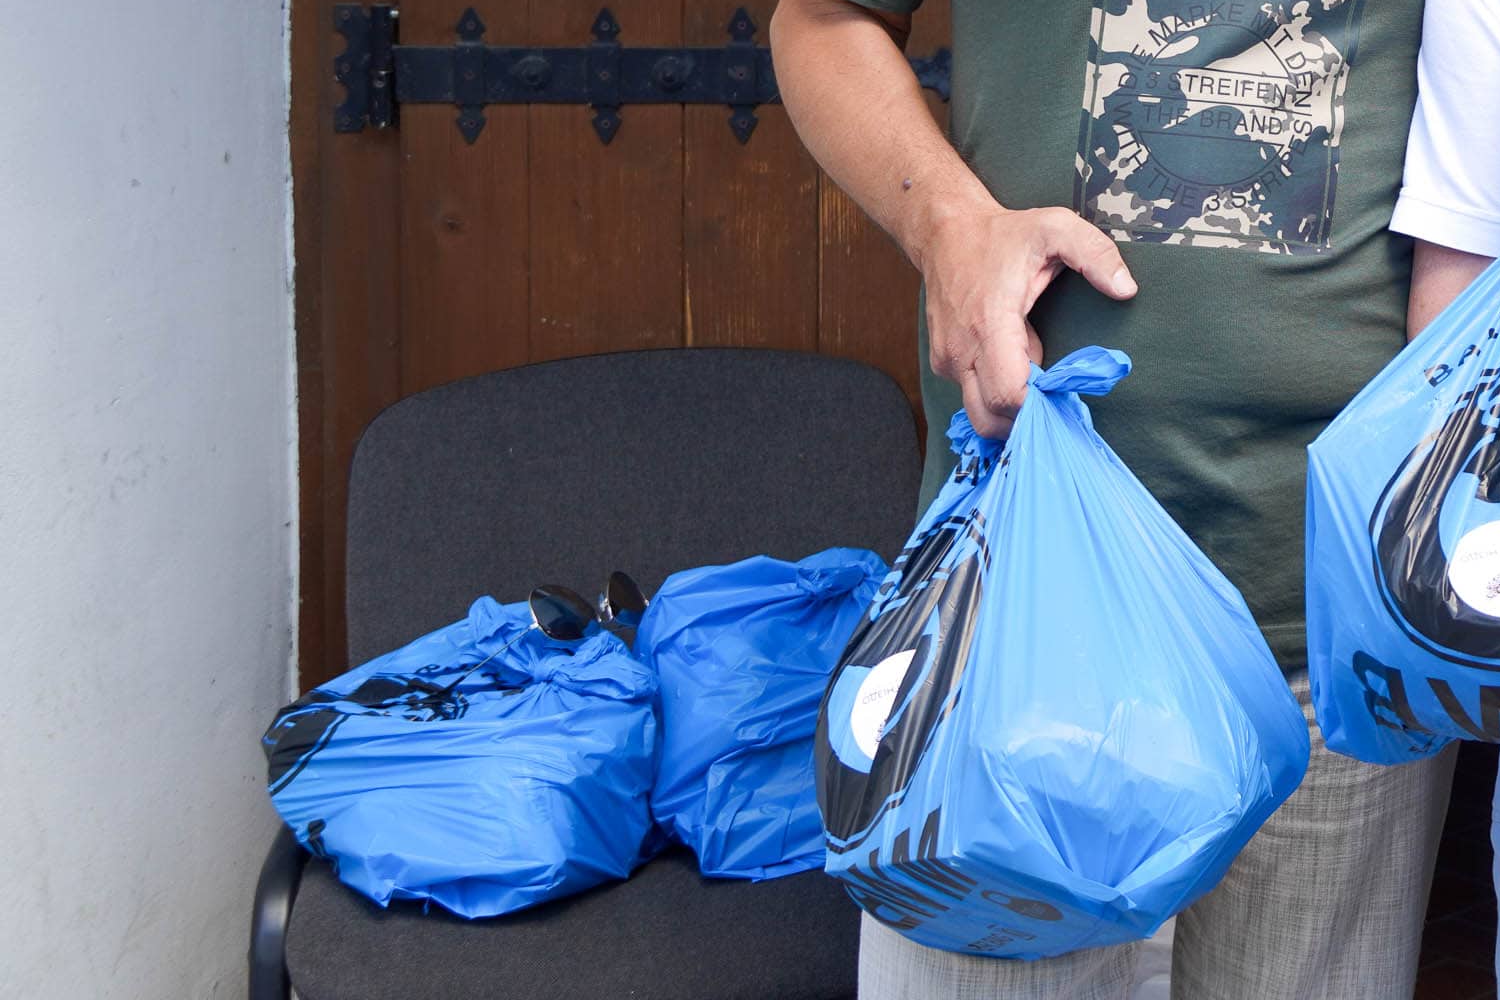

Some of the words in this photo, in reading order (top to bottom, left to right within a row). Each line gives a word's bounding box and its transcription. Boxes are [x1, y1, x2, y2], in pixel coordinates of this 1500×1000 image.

[1145, 73, 1158, 89] 3
[1168, 73, 1296, 104] STREIFEN
[1148, 2, 1244, 47] MARKE
[1251, 10, 1293, 48] MIT
[1285, 51, 1313, 108] DEN
[1143, 105, 1190, 126] THE
[1200, 110, 1283, 135] BRAND
[1113, 102, 1149, 174] WITH
[1148, 167, 1200, 209] THE
[1206, 193, 1221, 212] 3
